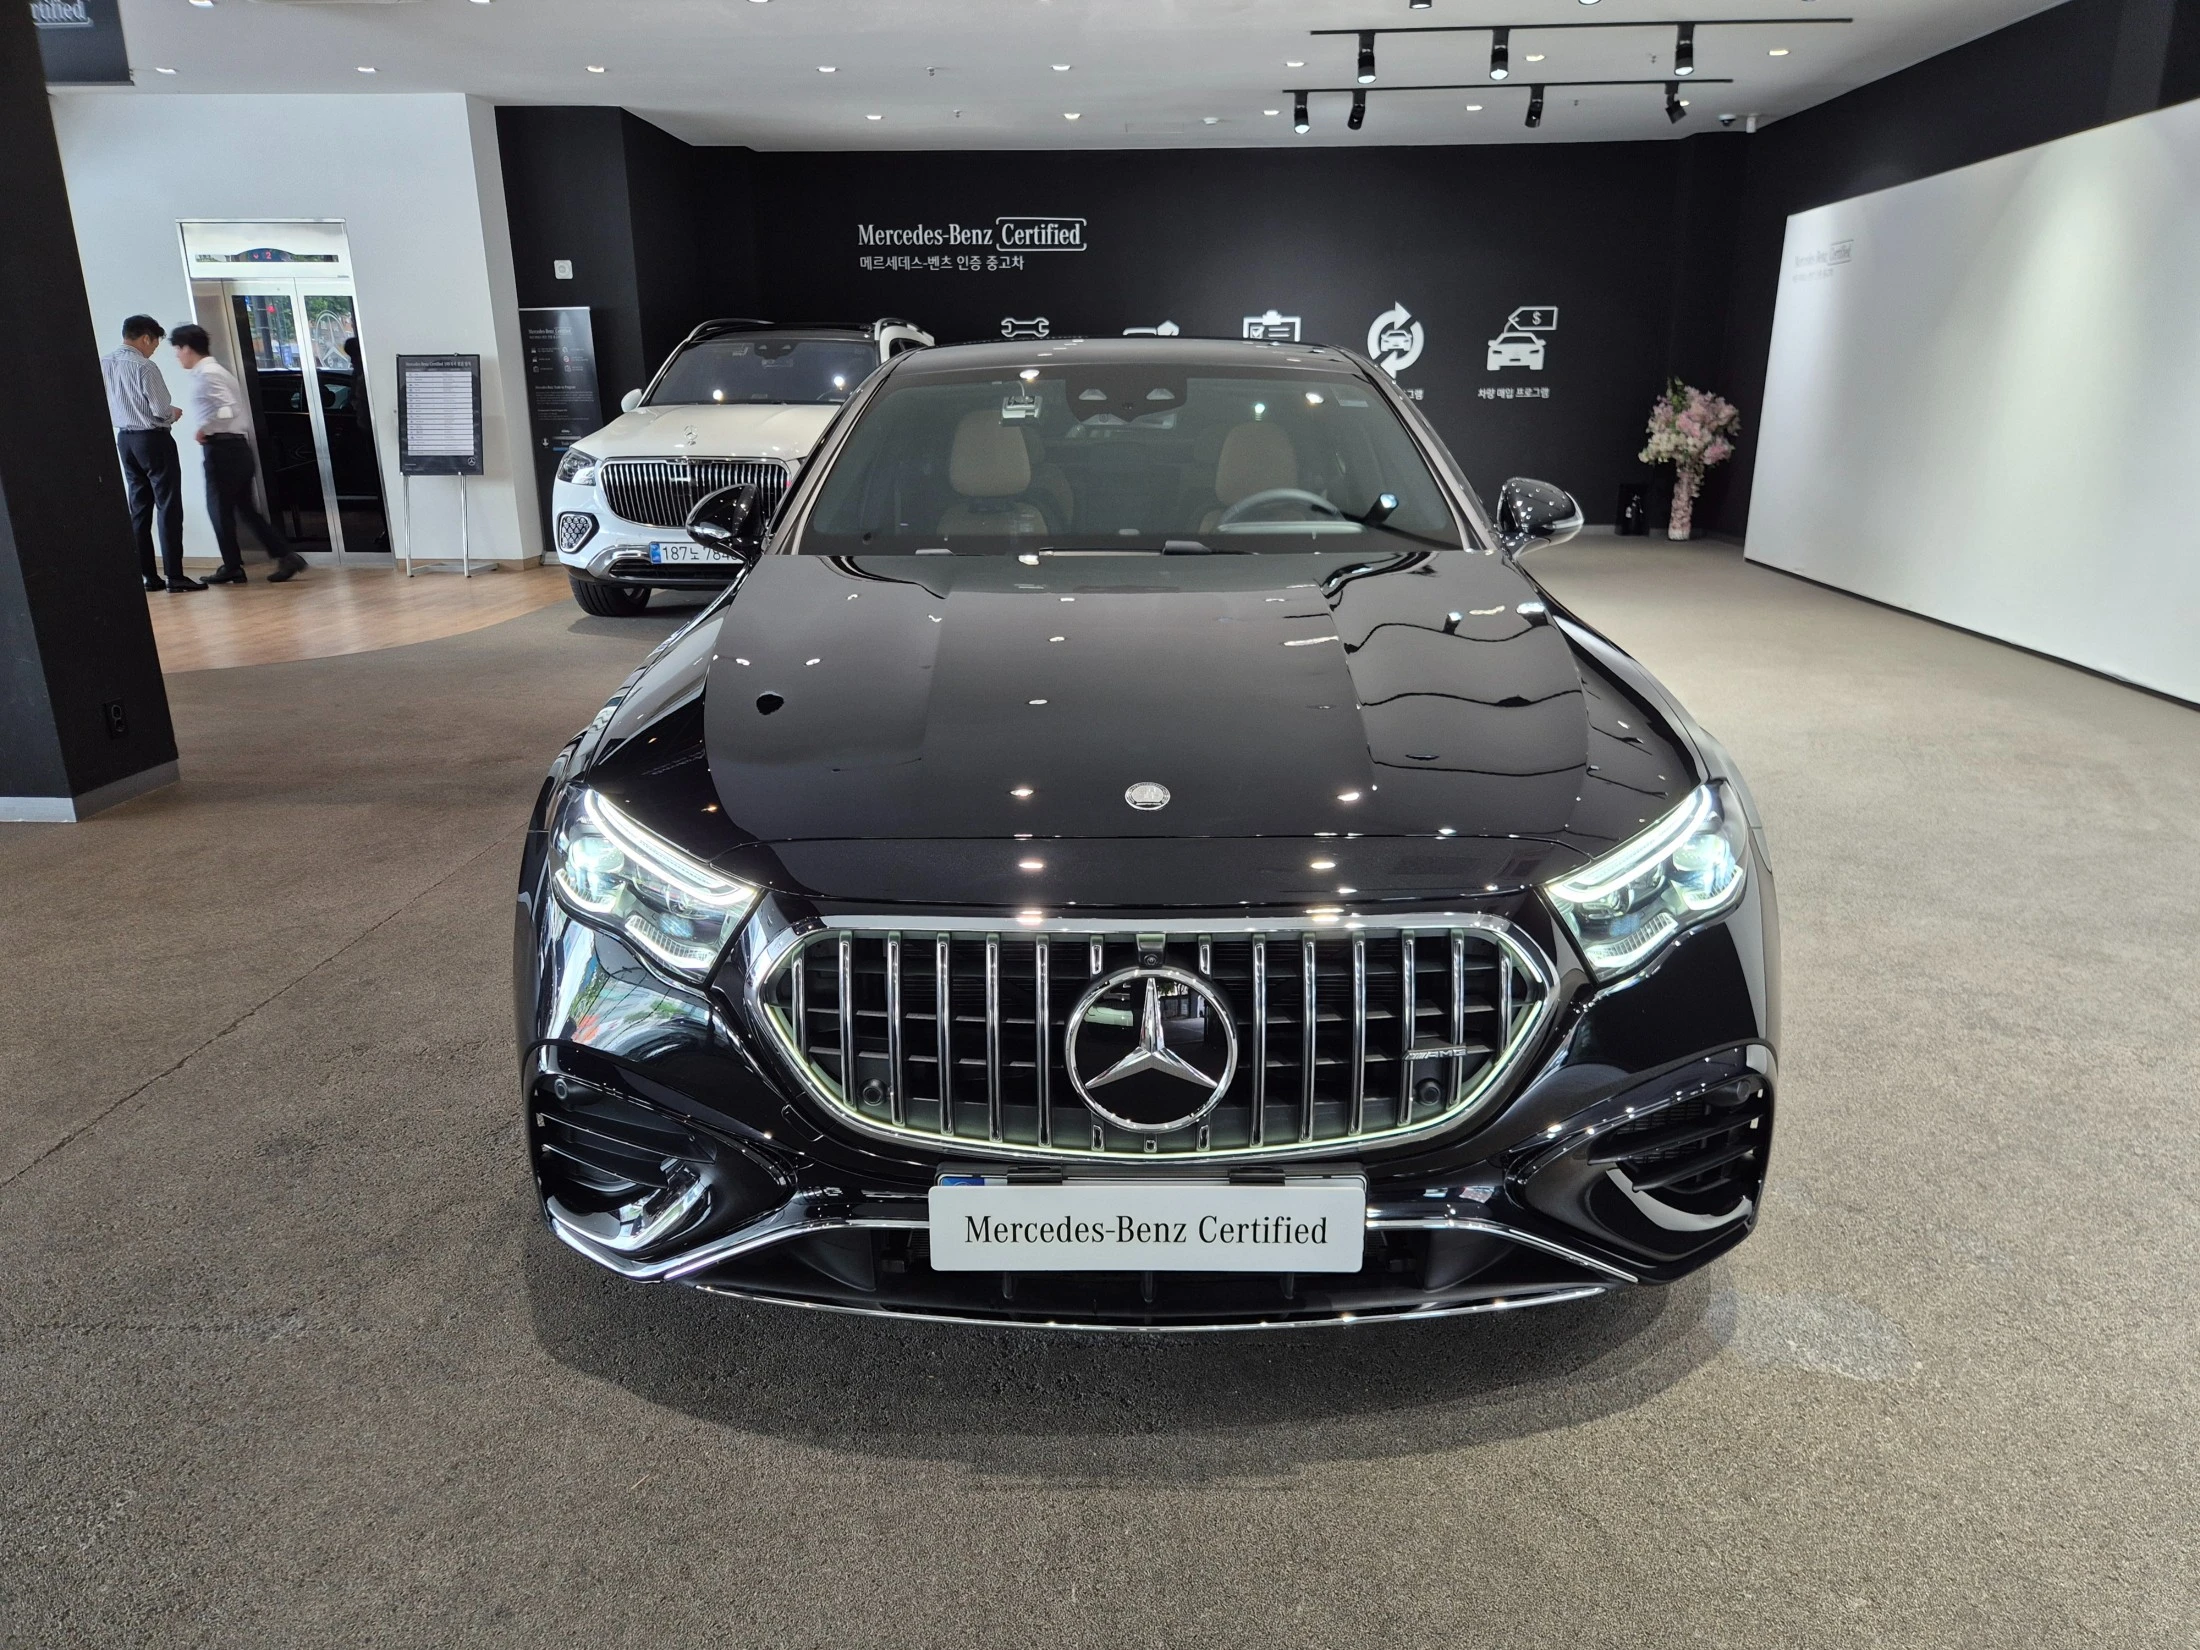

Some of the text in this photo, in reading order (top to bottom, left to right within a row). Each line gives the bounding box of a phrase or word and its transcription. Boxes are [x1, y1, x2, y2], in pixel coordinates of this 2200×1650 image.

[857, 222, 1081, 246] Mercedes-Benz Certified
[265, 251, 272, 260] 2
[859, 255, 1025, 271] 메르세데스-벤츠 인증 중고차
[1532, 311, 1542, 325] $
[1404, 388, 1424, 400] 그램
[1477, 388, 1496, 400] 차량
[1515, 387, 1550, 399] 프로그램
[662, 546, 738, 561] 187노 784
[964, 1214, 1328, 1244] Mercedes-Benz Certified
